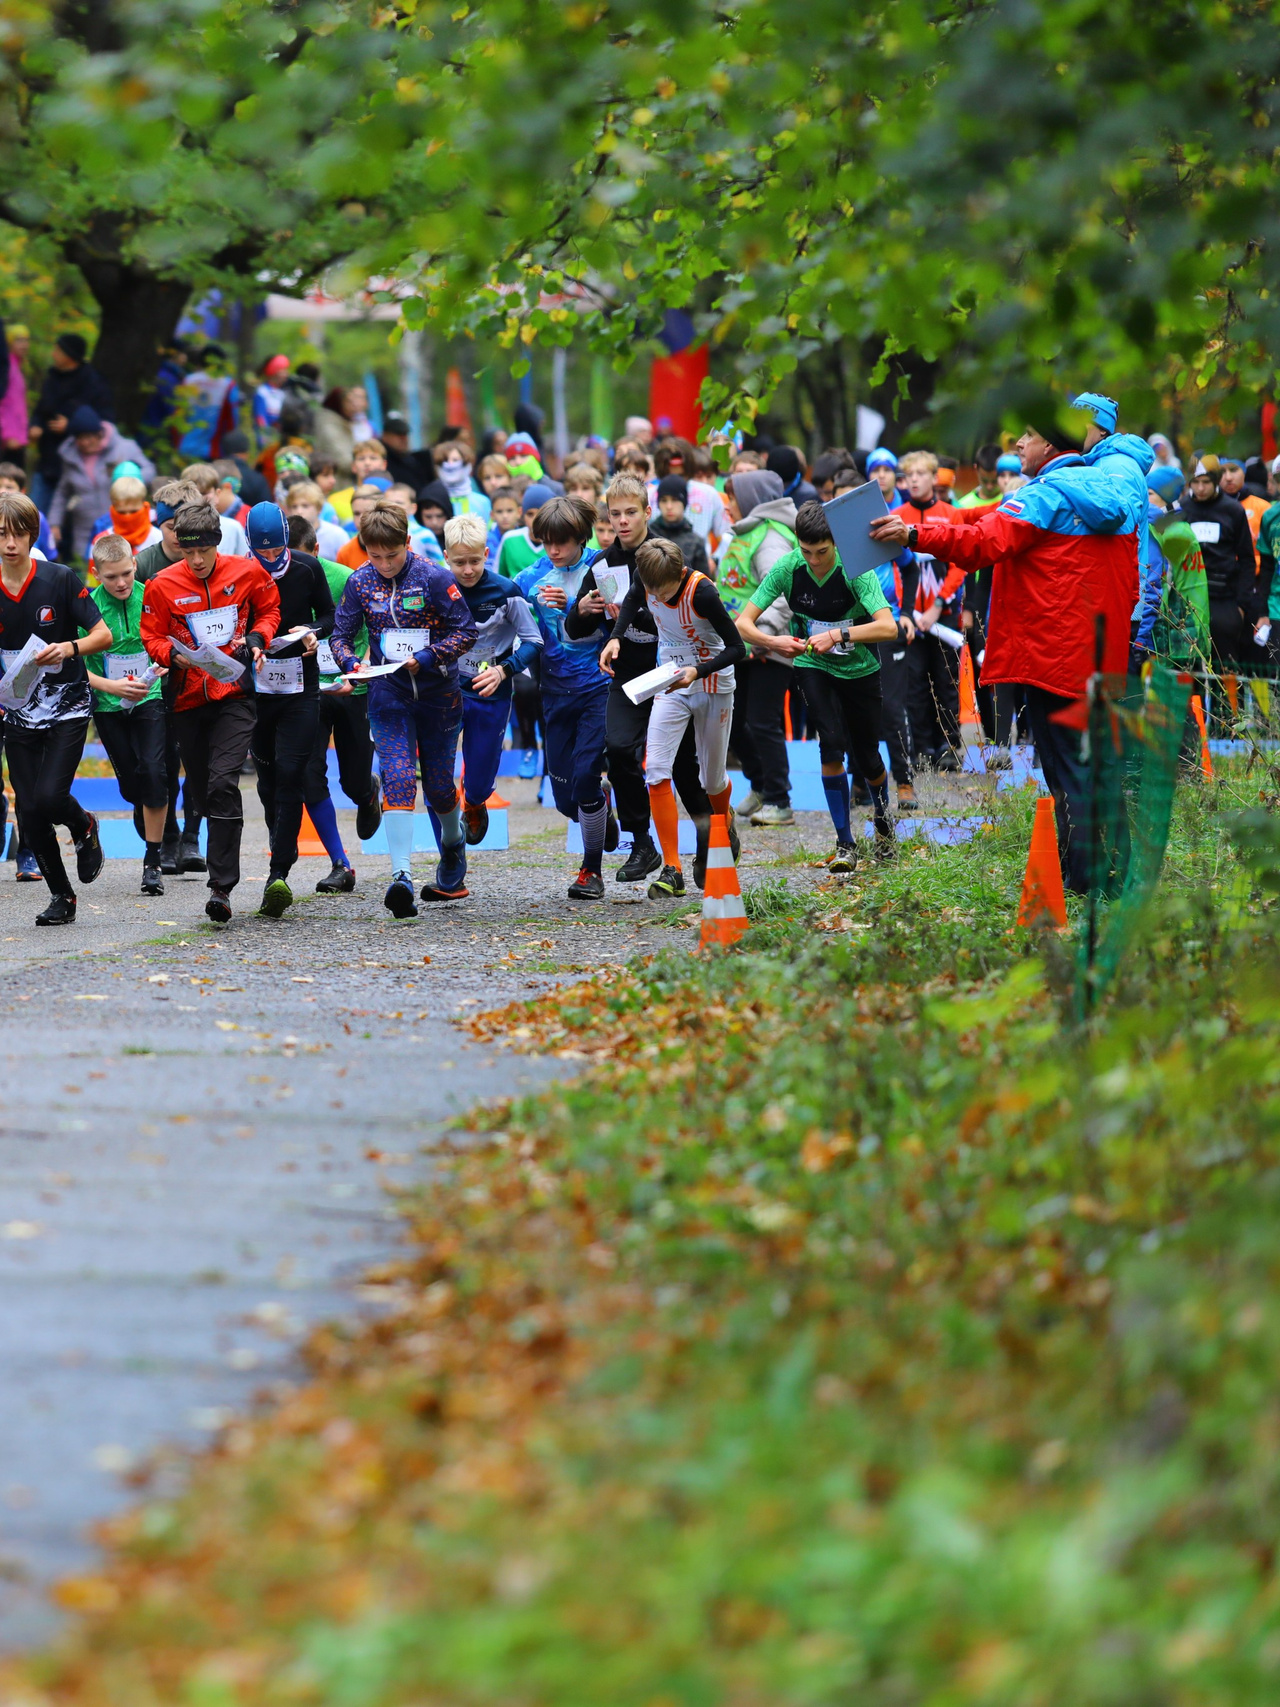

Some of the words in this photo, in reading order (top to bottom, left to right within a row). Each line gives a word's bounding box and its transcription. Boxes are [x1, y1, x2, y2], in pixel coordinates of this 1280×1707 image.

[407, 598, 421, 607] SFR
[206, 623, 224, 634] 279
[396, 643, 414, 652] 276
[123, 669, 138, 678] 291
[268, 672, 286, 681] 278
